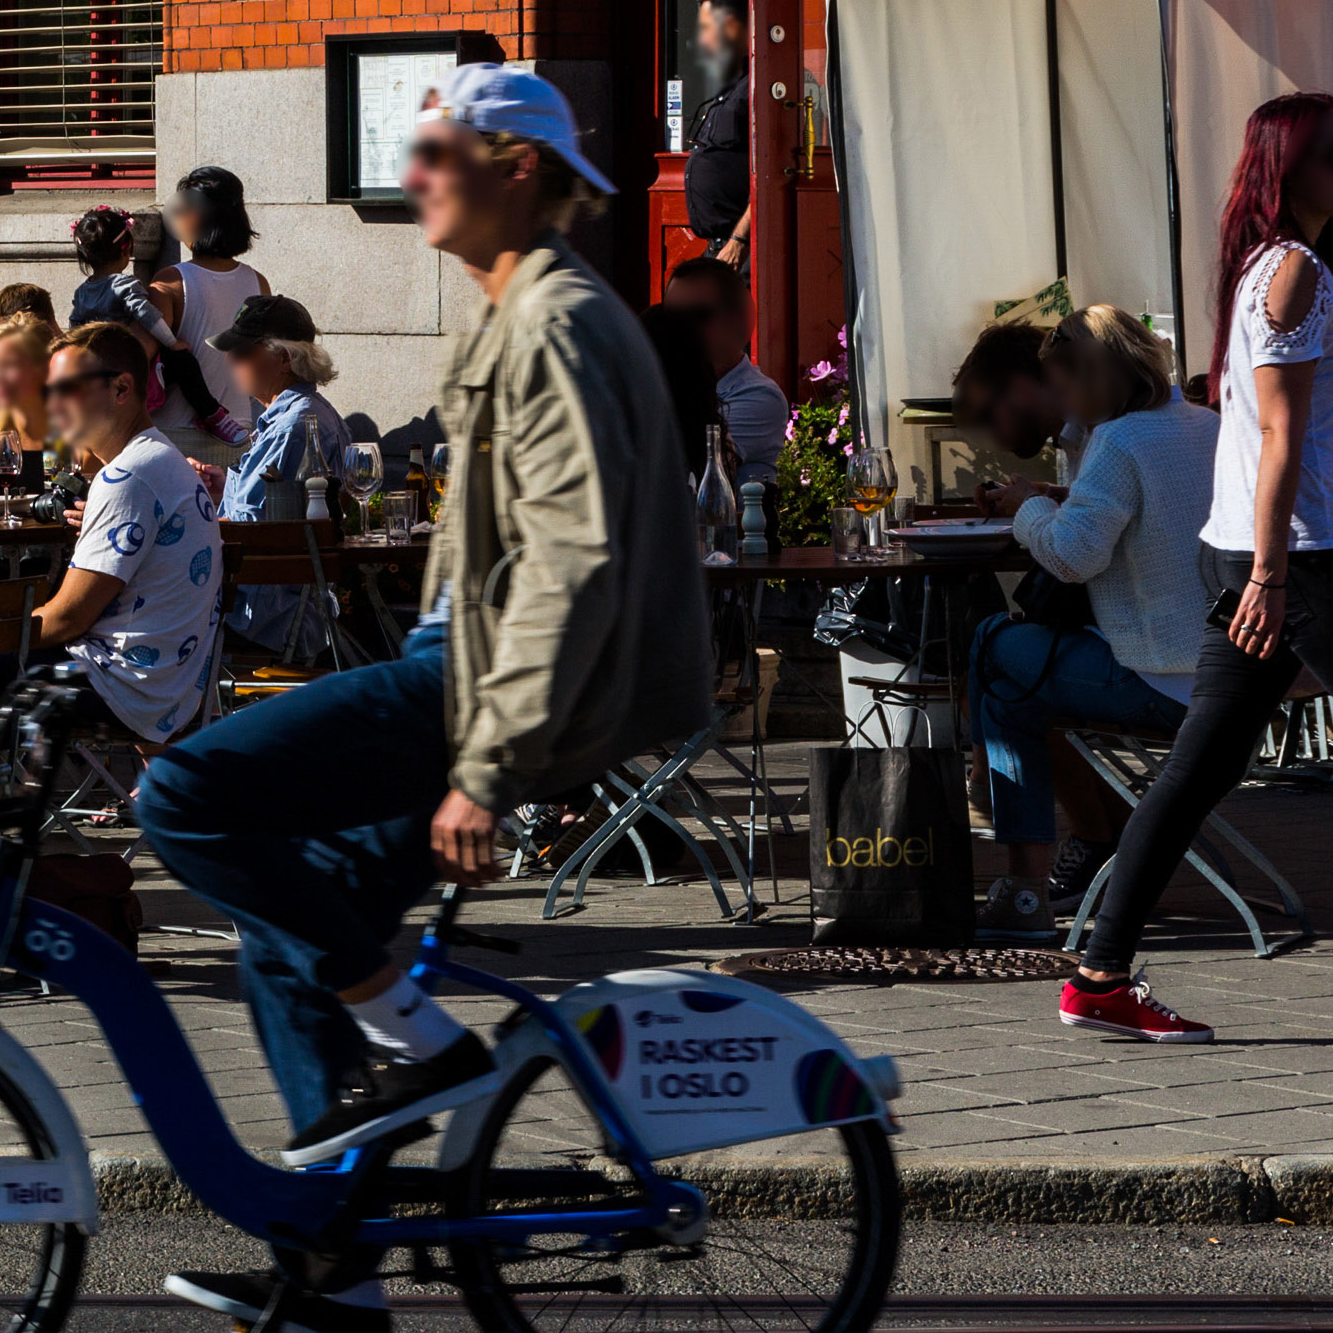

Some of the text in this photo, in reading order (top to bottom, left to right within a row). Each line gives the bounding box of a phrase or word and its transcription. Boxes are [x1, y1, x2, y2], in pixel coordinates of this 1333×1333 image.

[826, 826, 934, 867] babel
[639, 1036, 780, 1065] RASKEST
[640, 1071, 751, 1100] I OSLO
[2, 1181, 65, 1205] Telia
